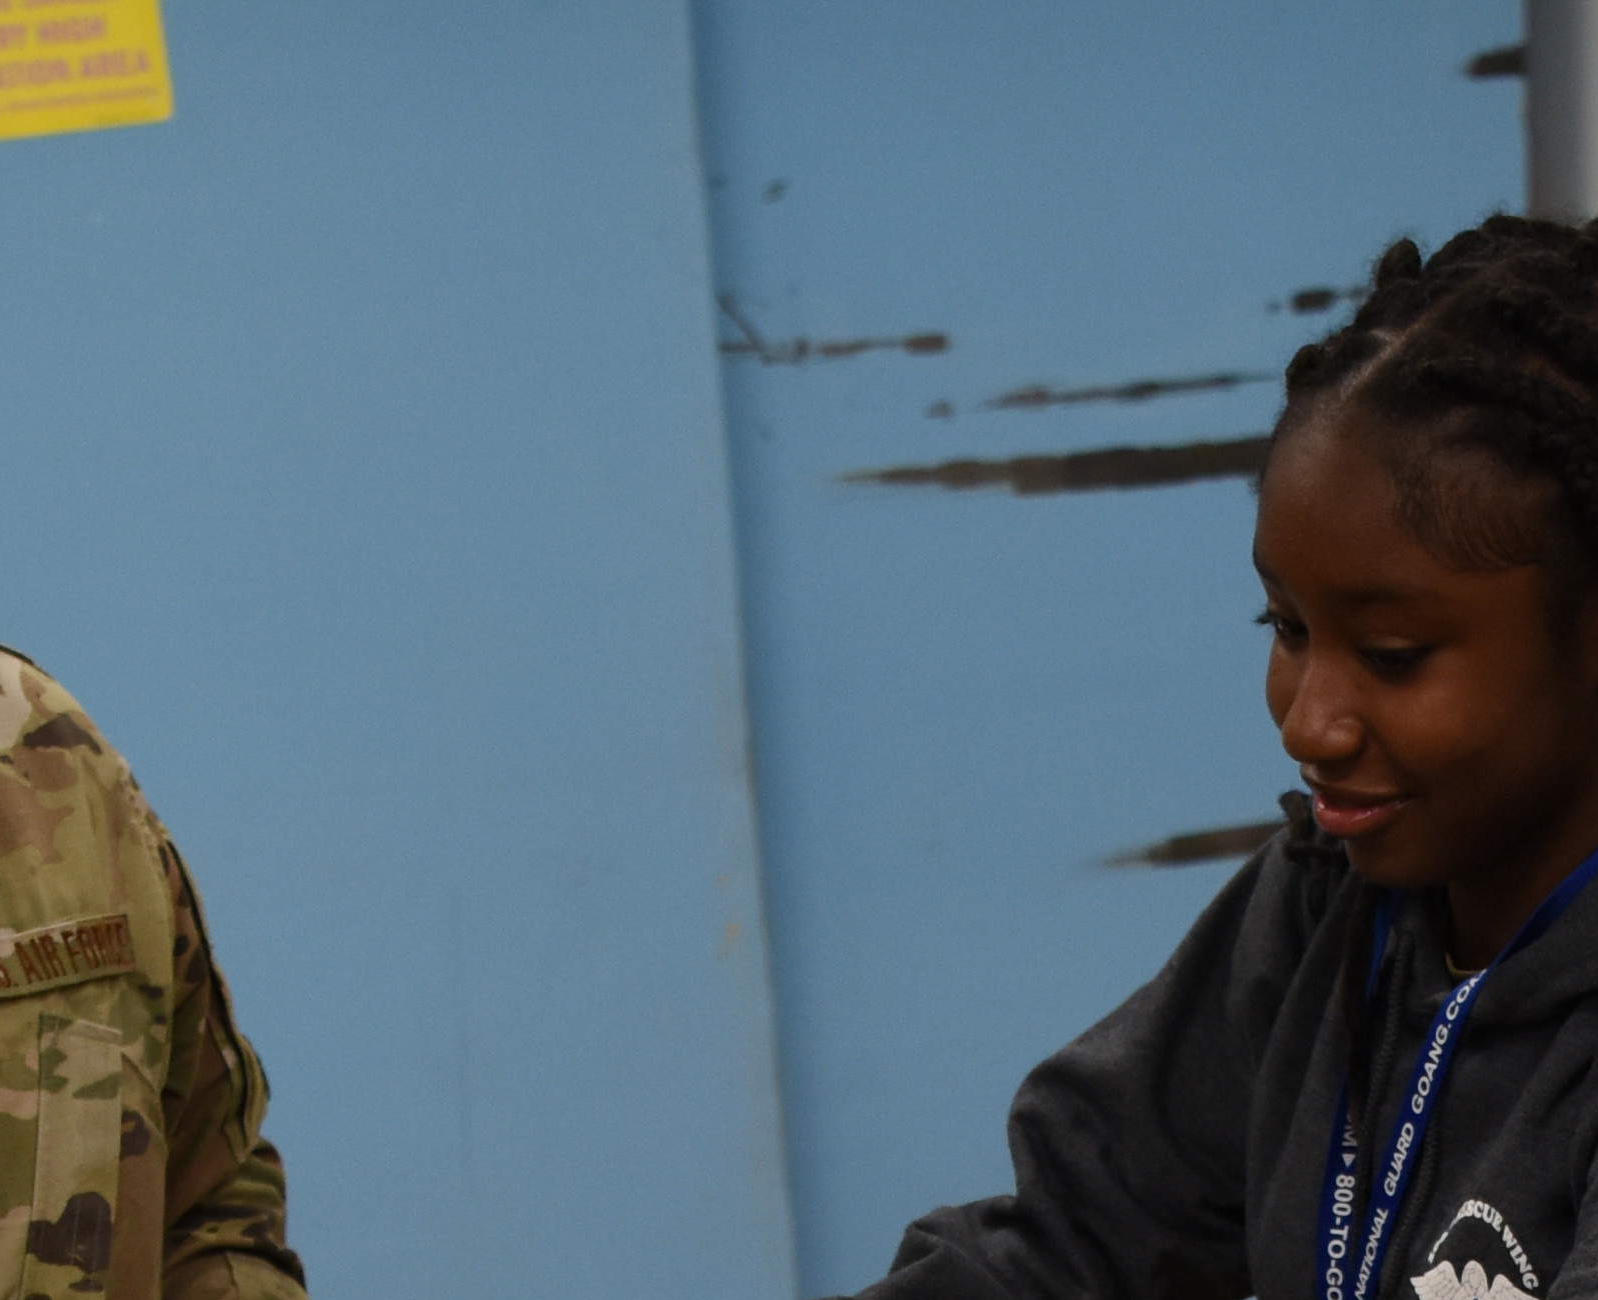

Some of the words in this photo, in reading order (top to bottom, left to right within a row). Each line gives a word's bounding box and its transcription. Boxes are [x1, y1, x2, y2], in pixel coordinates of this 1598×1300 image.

[14, 934, 67, 985] AIR
[1383, 1122, 1414, 1197] GUARD
[1502, 1224, 1539, 1290] WING
